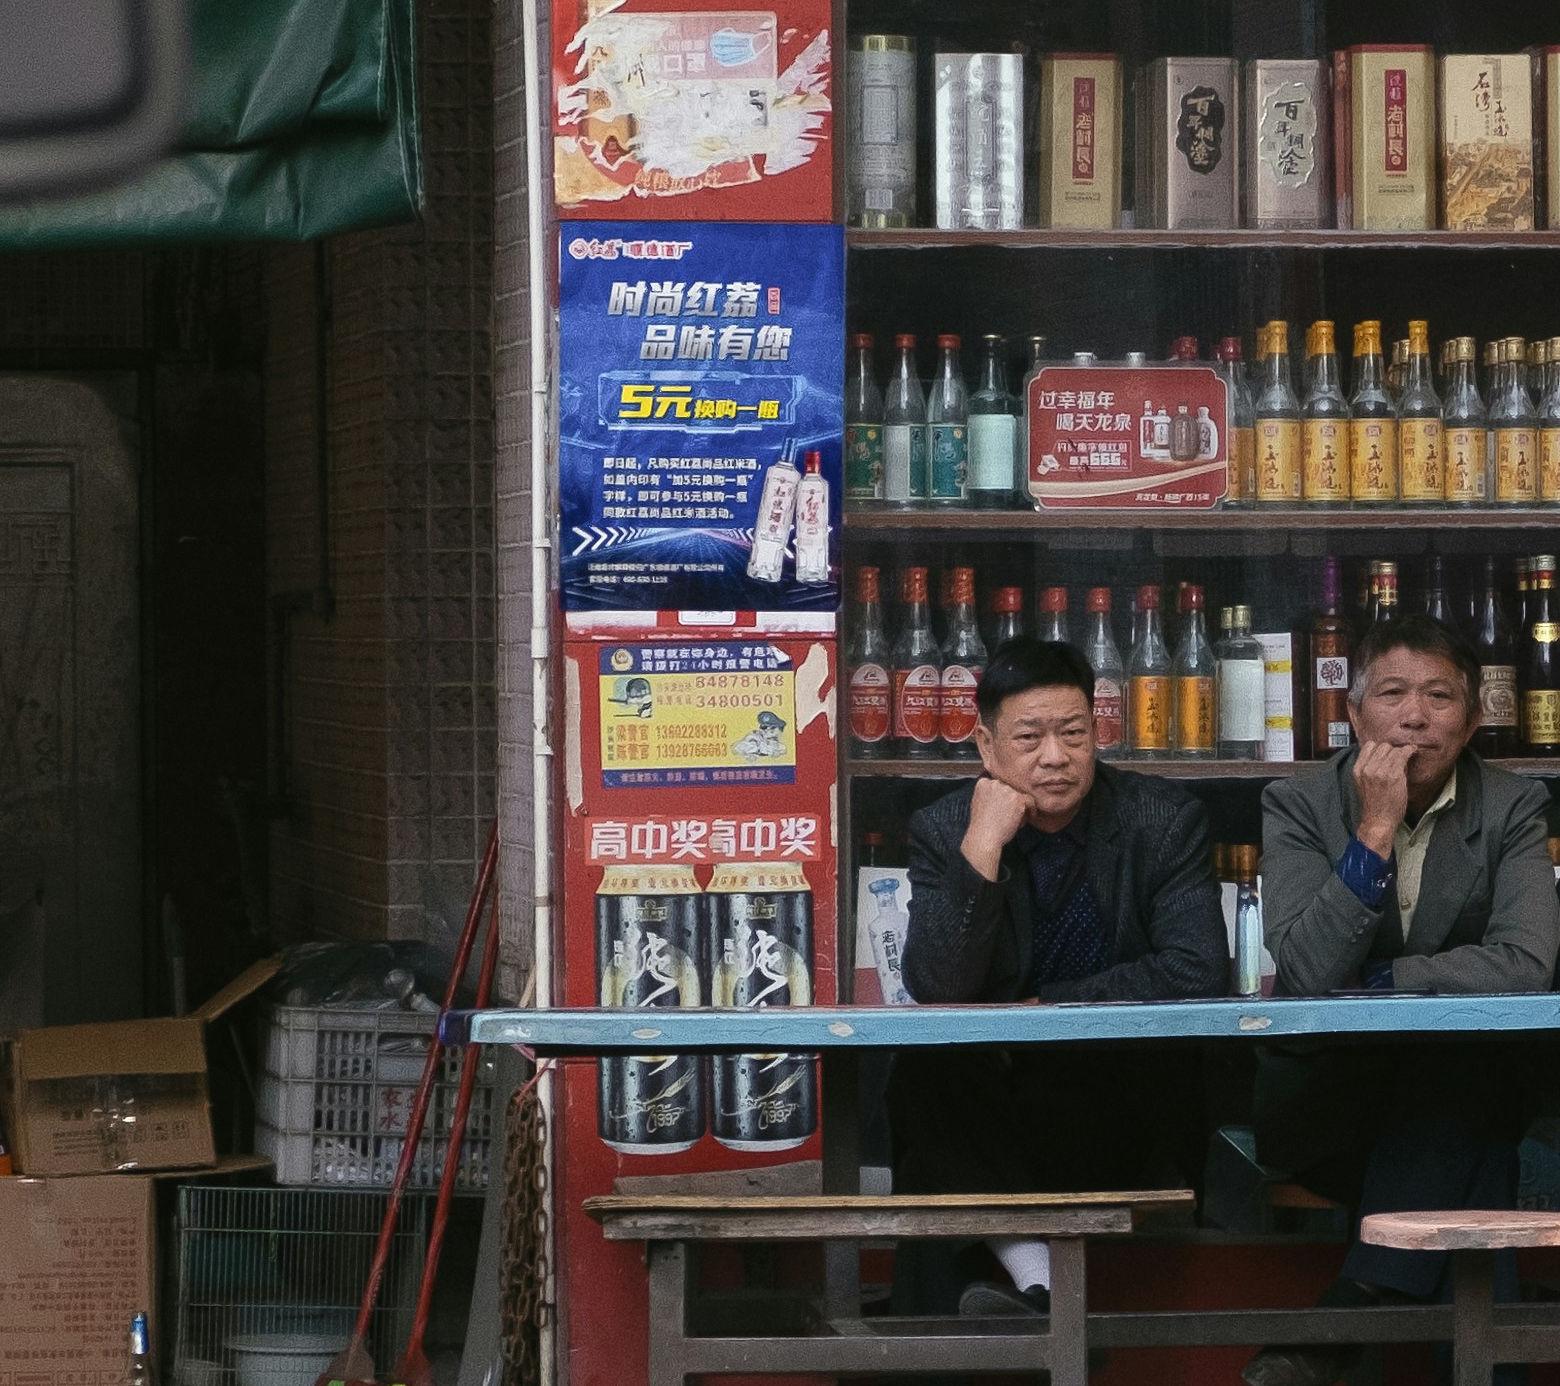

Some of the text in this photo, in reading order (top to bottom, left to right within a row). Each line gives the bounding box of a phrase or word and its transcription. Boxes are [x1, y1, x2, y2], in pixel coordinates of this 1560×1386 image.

[607, 280, 762, 318] 时尚红荔
[639, 324, 793, 361] 品味有您
[1039, 390, 1116, 411] 过幸福年
[1056, 412, 1132, 432] 喝天龙泉
[695, 694, 785, 710] 34800501
